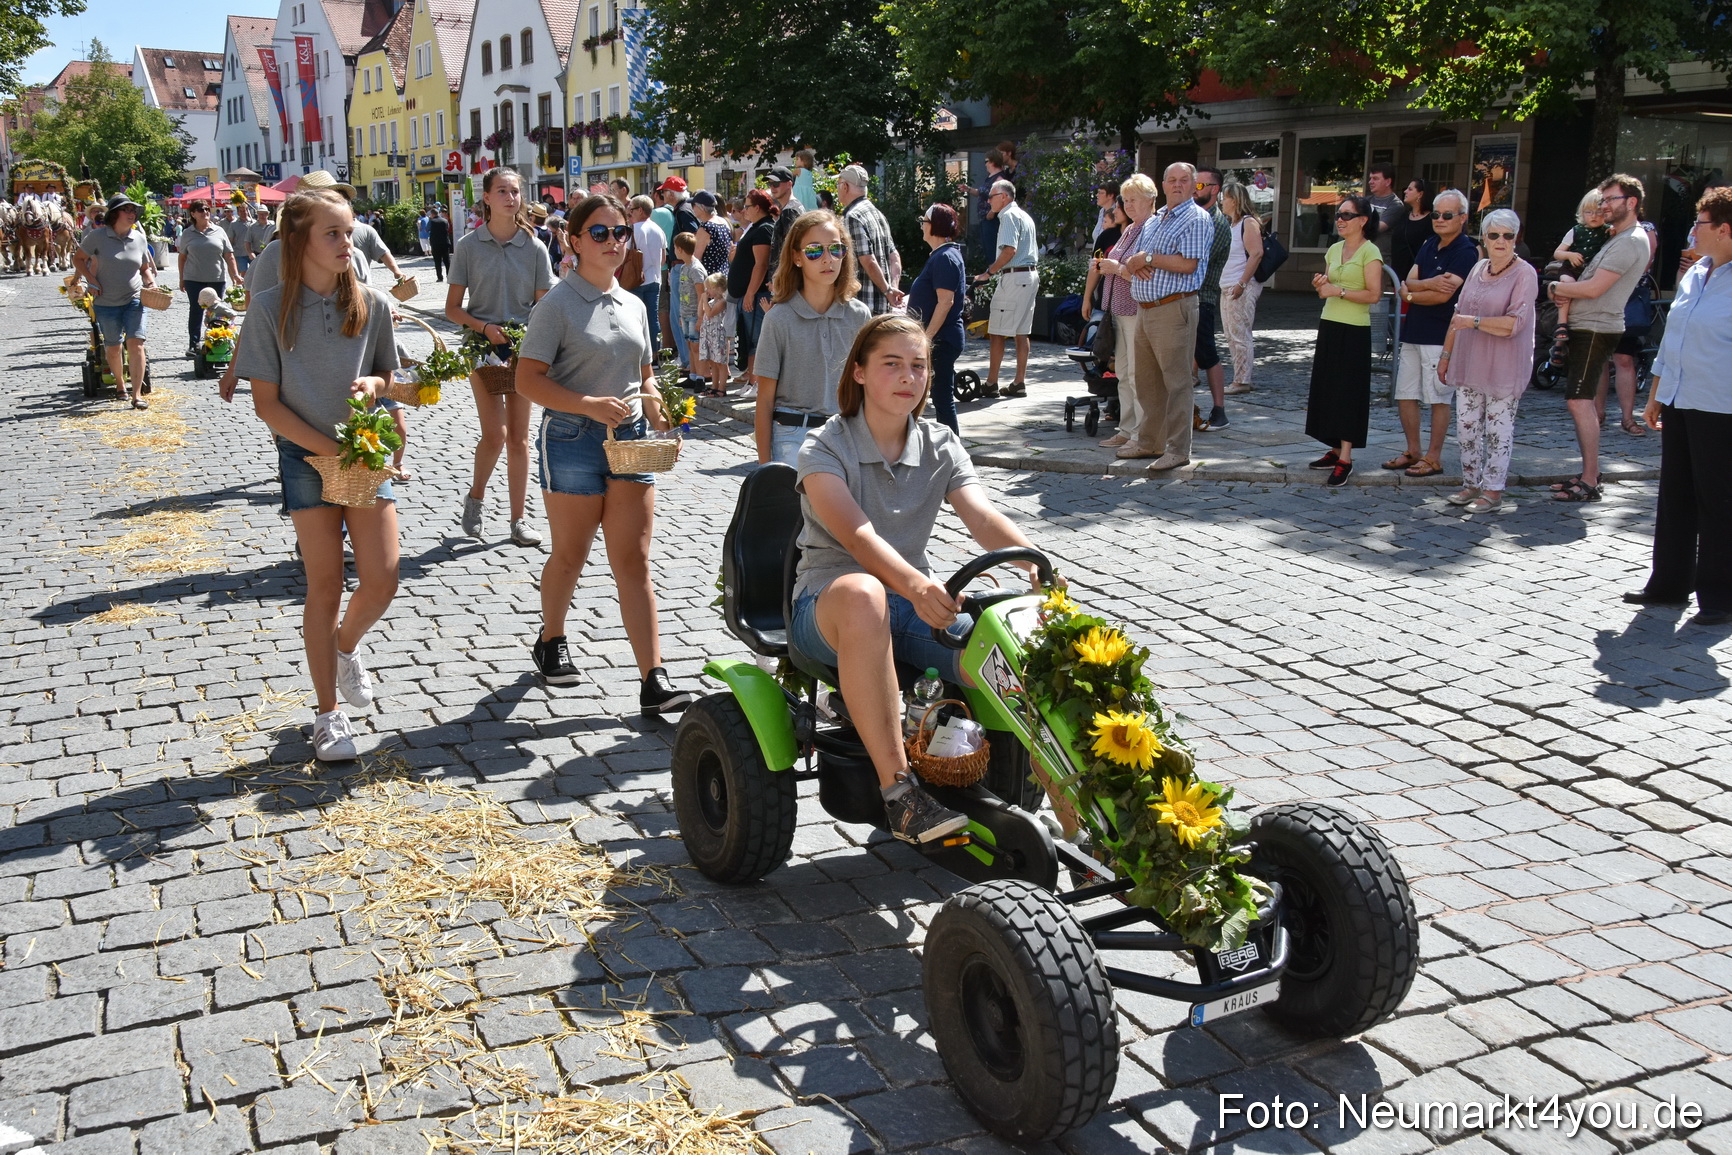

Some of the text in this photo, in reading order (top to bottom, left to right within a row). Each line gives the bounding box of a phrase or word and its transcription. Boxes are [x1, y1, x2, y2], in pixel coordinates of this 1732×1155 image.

[298, 39, 310, 65] K&L
[371, 106, 385, 120] HOTEL
[570, 158, 579, 172] P
[1220, 945, 1257, 967] BERG
[1223, 990, 1258, 1013] KRAUS
